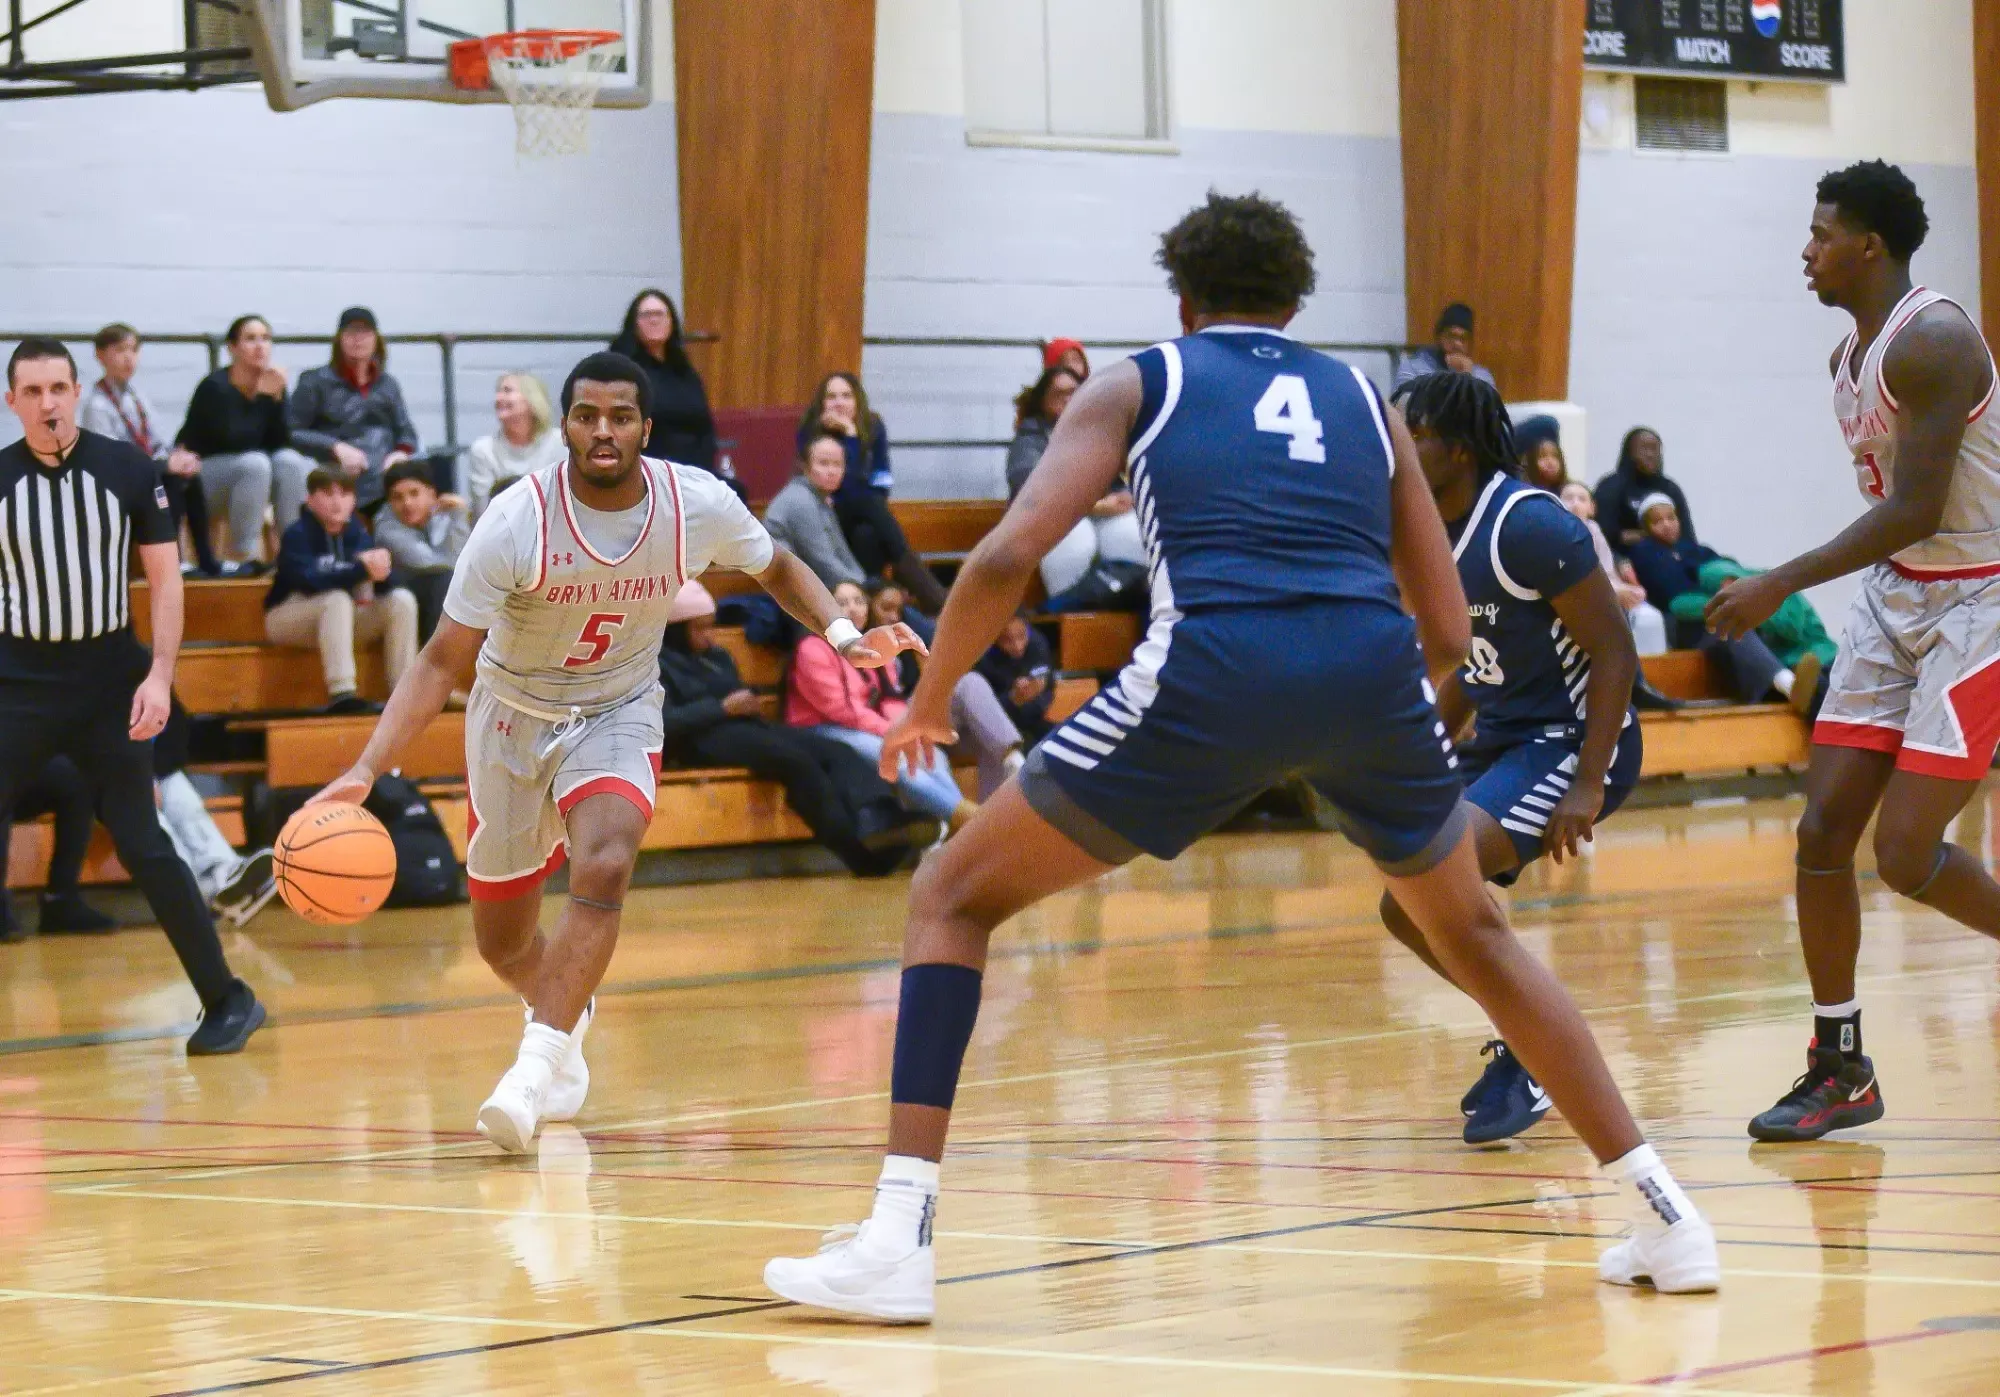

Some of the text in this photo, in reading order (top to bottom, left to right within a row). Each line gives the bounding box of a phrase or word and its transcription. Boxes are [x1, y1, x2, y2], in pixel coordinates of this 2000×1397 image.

[1676, 37, 1731, 64] MATCH
[1780, 42, 1832, 70] SCORE
[1253, 374, 1326, 464] 4
[546, 574, 672, 605] BRYN ATHYN
[562, 612, 628, 668] 5
